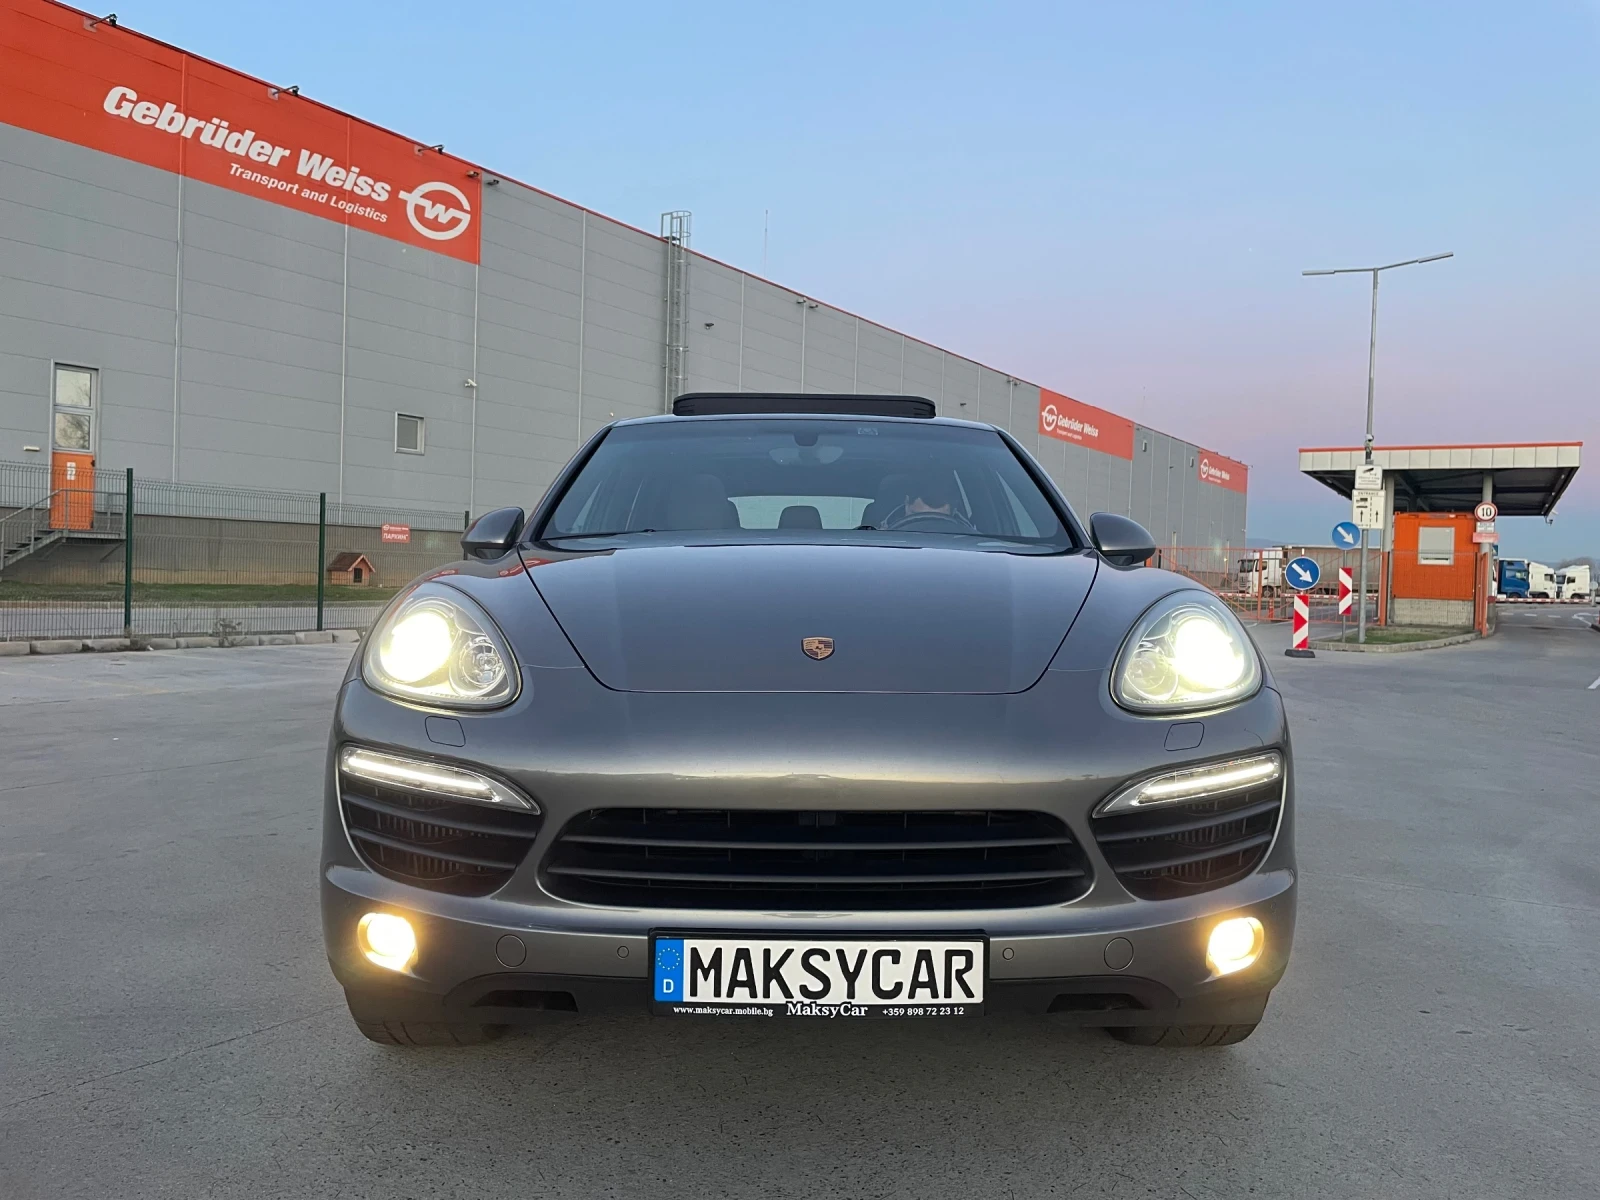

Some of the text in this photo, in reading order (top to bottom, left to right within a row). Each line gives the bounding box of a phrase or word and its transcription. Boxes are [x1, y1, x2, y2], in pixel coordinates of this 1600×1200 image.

[103, 86, 391, 202] Gebrüder Weiss
[229, 163, 388, 223] Transport and Logistics
[1057, 414, 1083, 432] Gebrüder
[1083, 422, 1099, 437] Weiss
[1481, 507, 1492, 517] 10
[663, 947, 975, 1000] D MAKSYCAR
[673, 1006, 774, 1017] www.maksycar.mobile.bg
[786, 1003, 868, 1019] MaksyCar
[882, 1007, 964, 1016] +359 898 72 23 12
